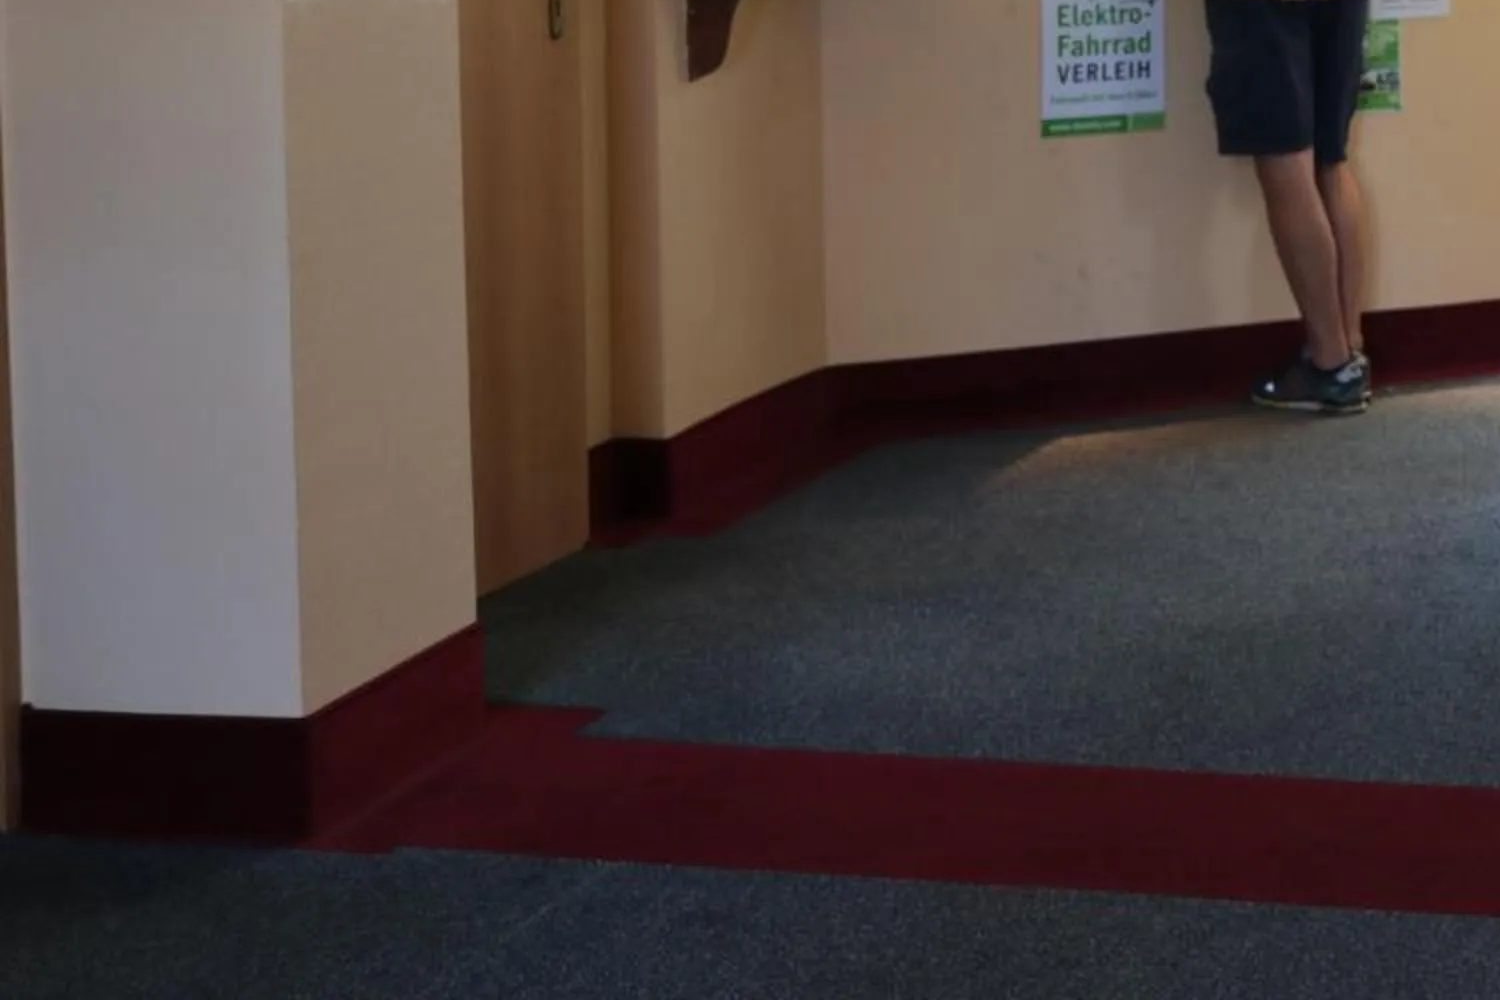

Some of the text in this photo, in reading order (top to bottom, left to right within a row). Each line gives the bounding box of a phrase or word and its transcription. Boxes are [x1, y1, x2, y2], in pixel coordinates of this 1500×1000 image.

[1057, 3, 1152, 28] Elektro-
[1057, 30, 1151, 57] Fahrrad
[1056, 60, 1151, 85] VERLEIH
